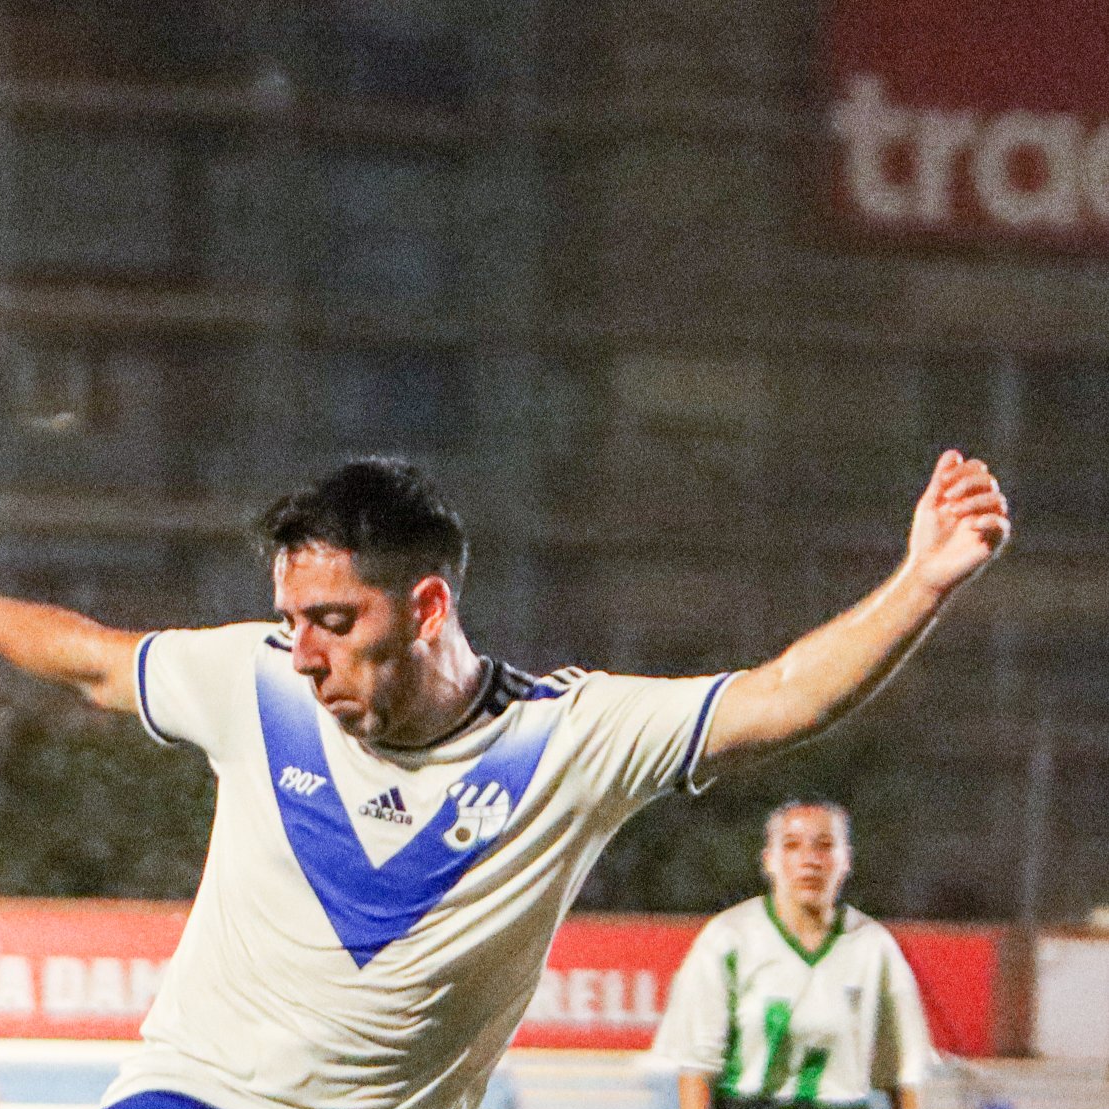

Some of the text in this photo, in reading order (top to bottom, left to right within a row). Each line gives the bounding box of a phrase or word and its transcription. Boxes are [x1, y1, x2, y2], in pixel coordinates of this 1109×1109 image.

[831, 72, 1109, 226] tra
[279, 765, 327, 796] 1907
[358, 804, 413, 825] adidas
[525, 968, 664, 1023] RELL
